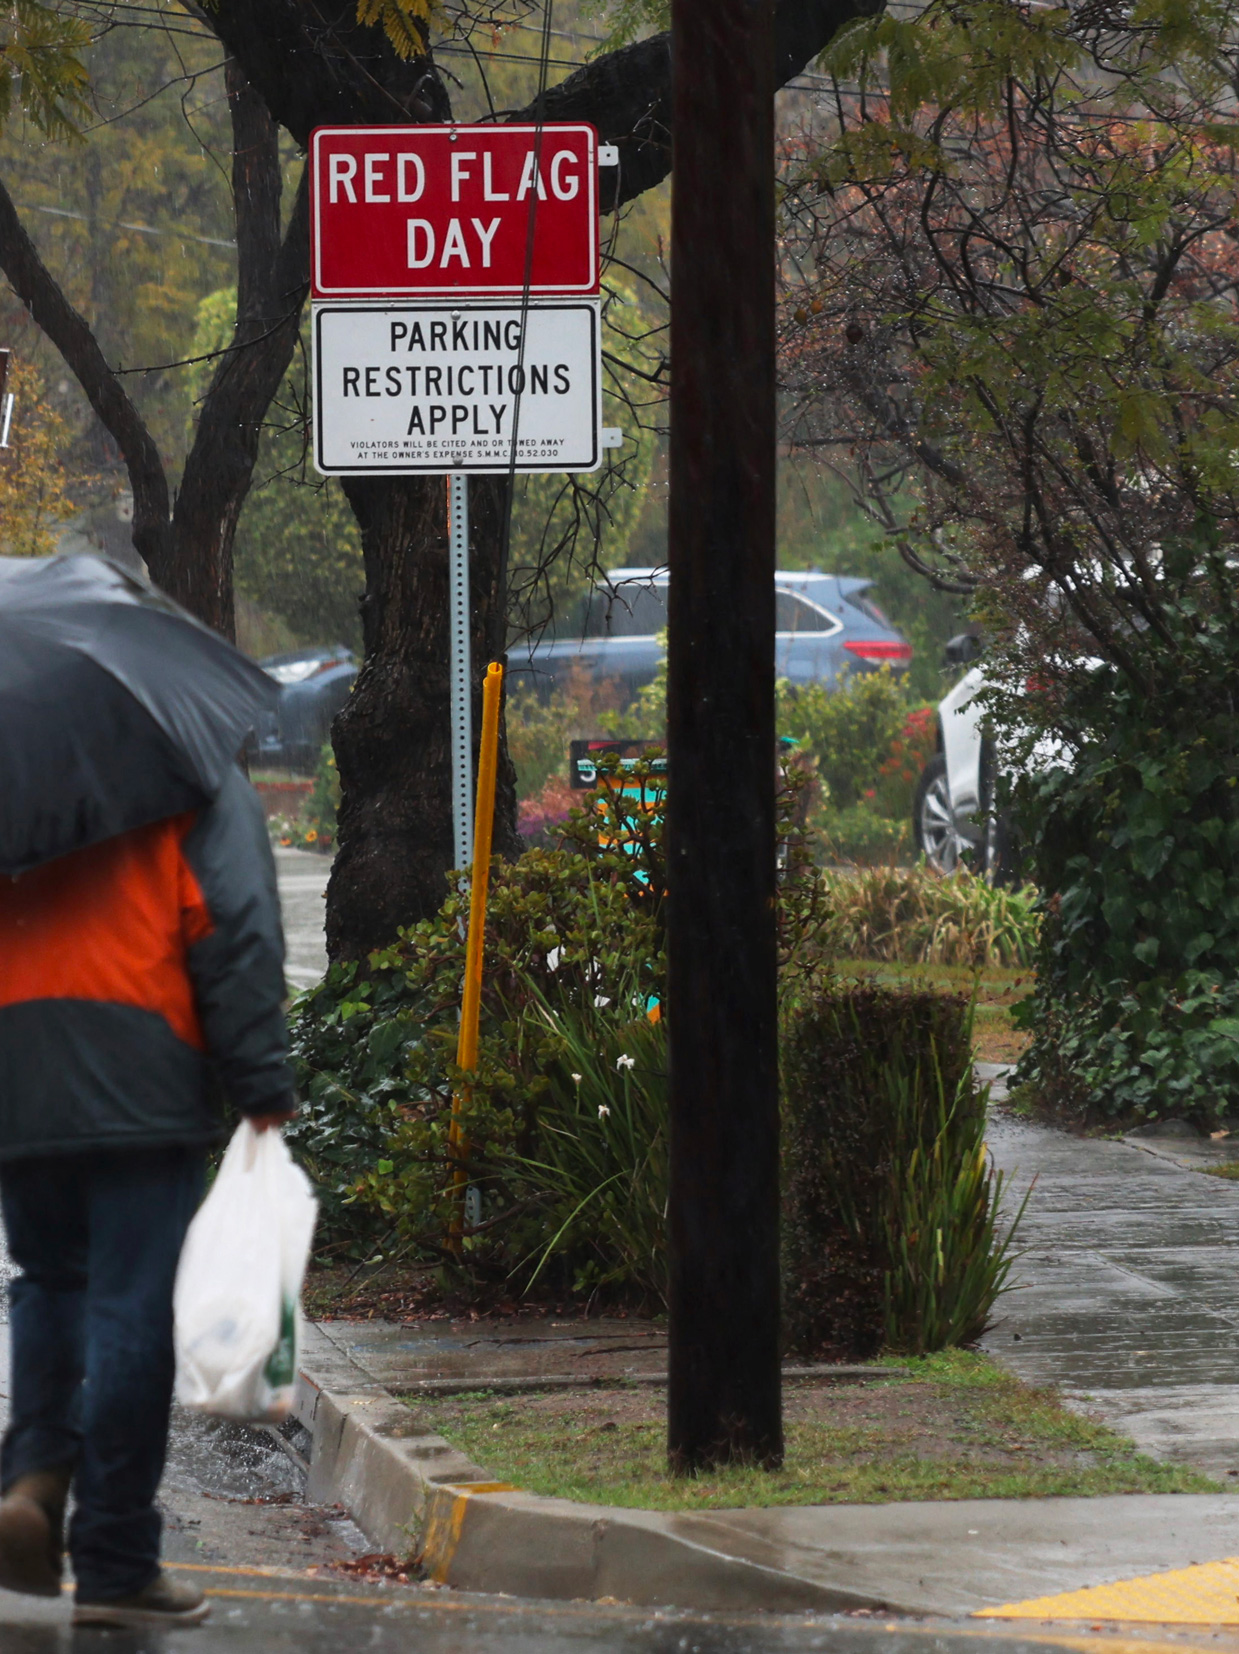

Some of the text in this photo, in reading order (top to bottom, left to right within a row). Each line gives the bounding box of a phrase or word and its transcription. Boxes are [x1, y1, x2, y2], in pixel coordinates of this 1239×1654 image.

[328, 150, 580, 204] RED FLAG
[406, 217, 502, 269] DAY
[390, 320, 522, 352] PARKING
[342, 364, 571, 397] RESTRICTIONS
[407, 404, 508, 436] APPLY
[350, 438, 565, 449] VIOLATORS WILL BE CITED AND OR TWED AWAY
[357, 451, 369, 459] AT
[371, 451, 389, 459] THE
[392, 451, 430, 459] OWNER'S
[433, 450, 473, 458] EXPENSE
